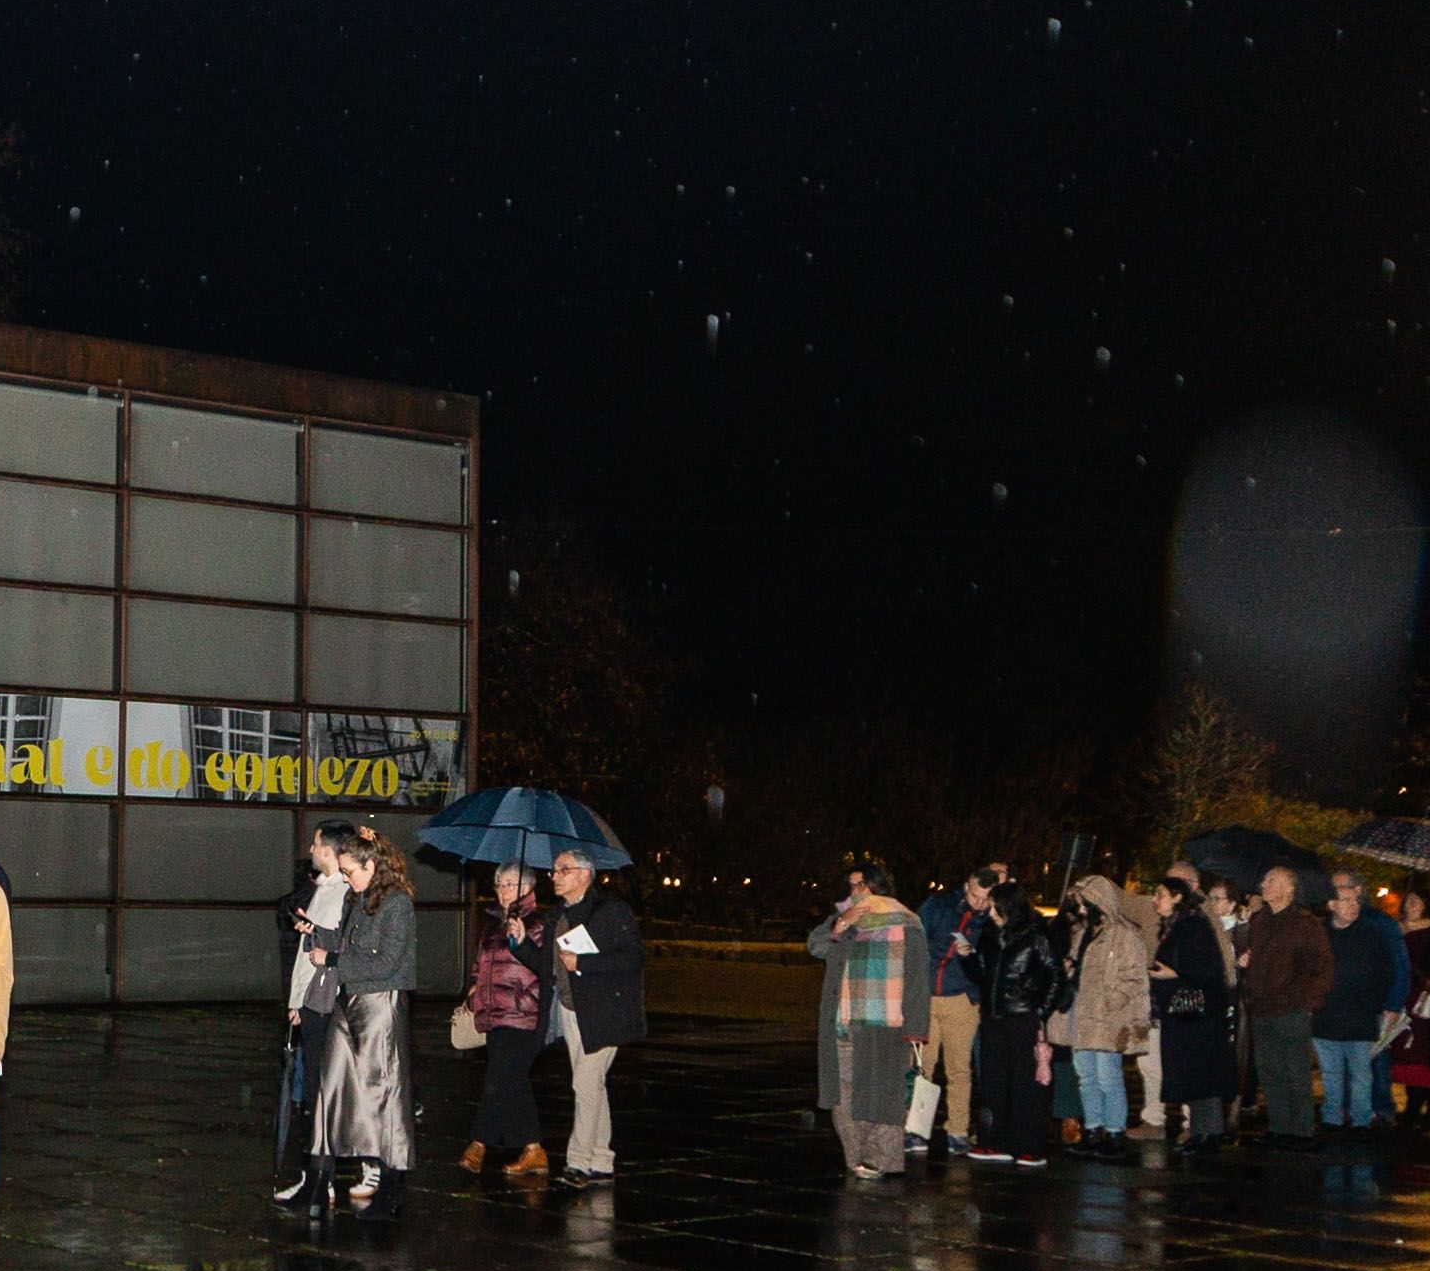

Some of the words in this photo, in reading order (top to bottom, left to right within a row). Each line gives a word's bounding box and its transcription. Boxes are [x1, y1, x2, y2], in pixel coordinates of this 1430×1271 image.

[85, 745, 114, 786] e
[127, 741, 191, 791] do
[204, 751, 399, 797] comezo
